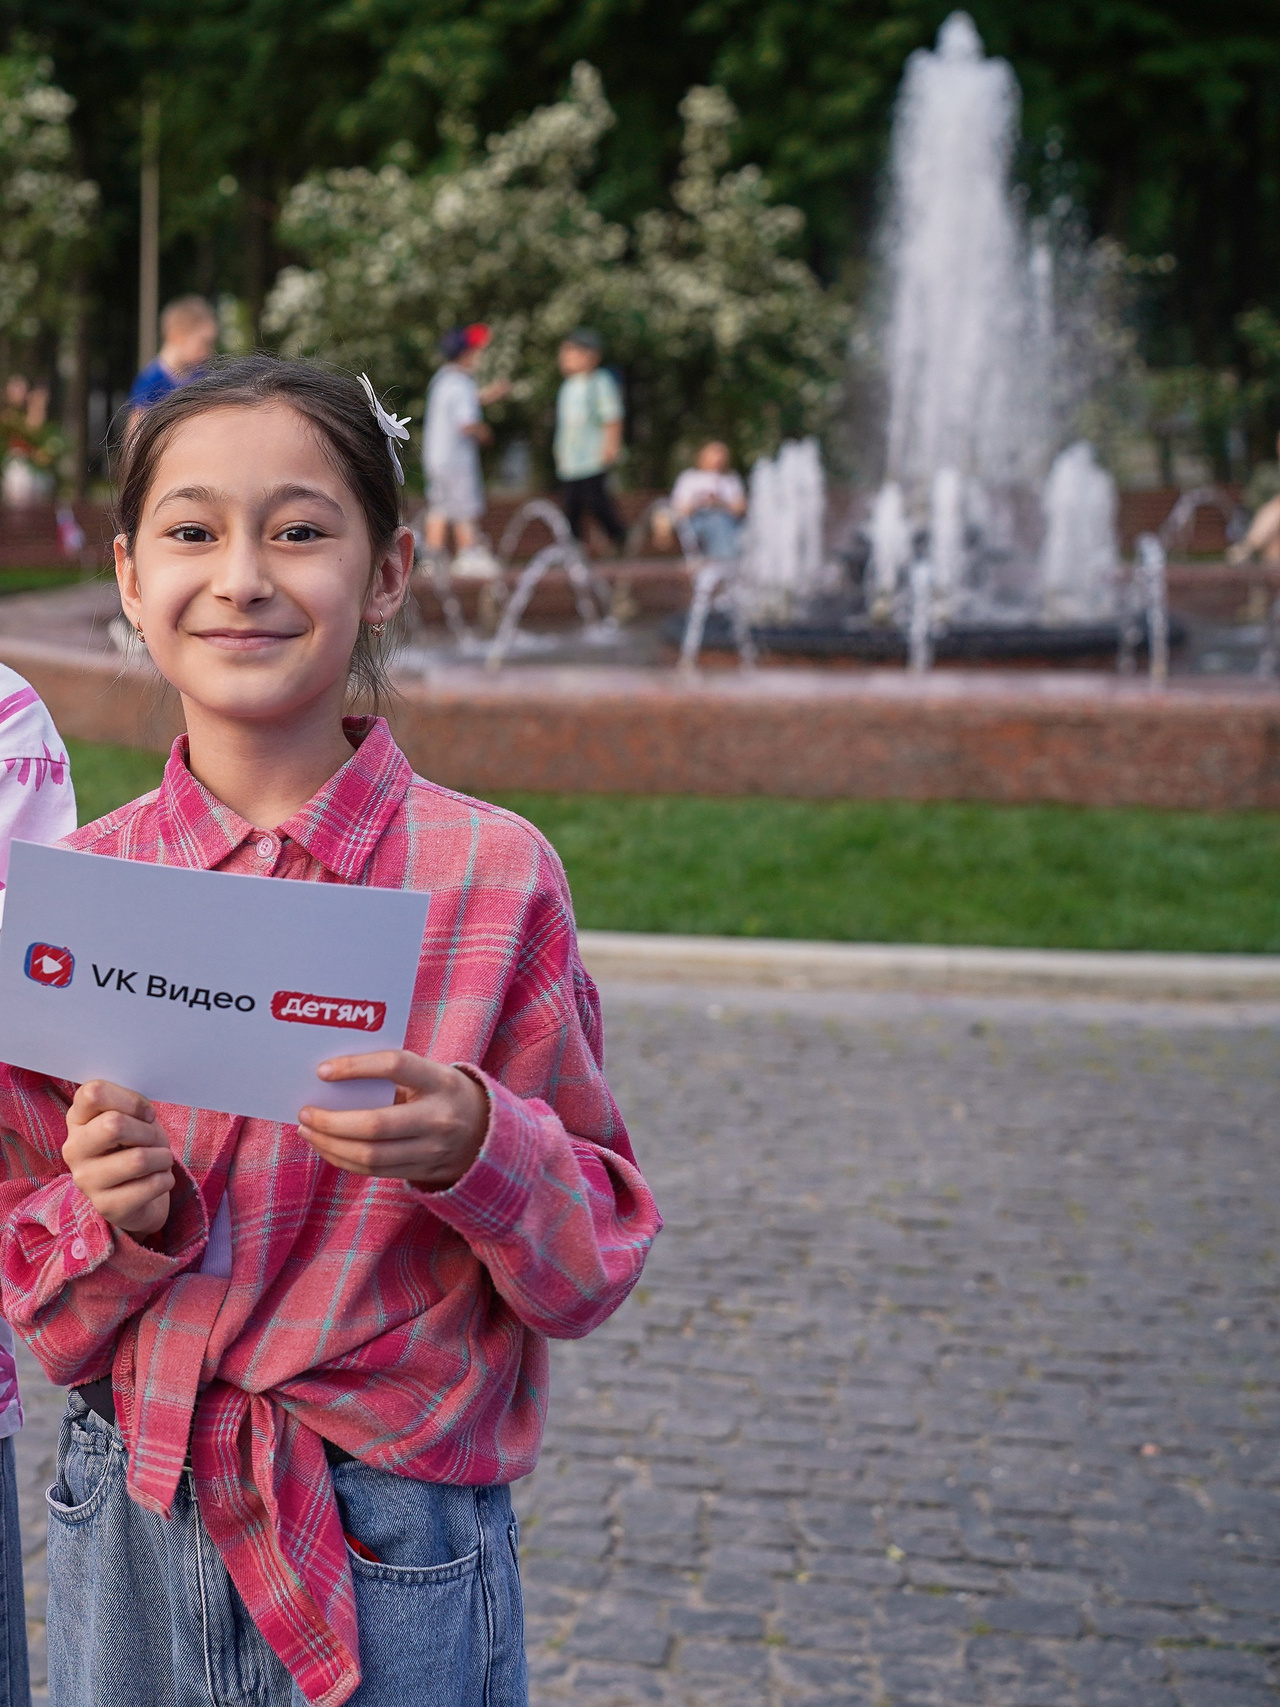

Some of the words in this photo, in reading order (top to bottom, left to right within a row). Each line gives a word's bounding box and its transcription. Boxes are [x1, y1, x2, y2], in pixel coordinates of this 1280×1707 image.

[91, 963, 139, 994] VK
[146, 974, 256, 1012] Видео
[280, 997, 376, 1030] детям
